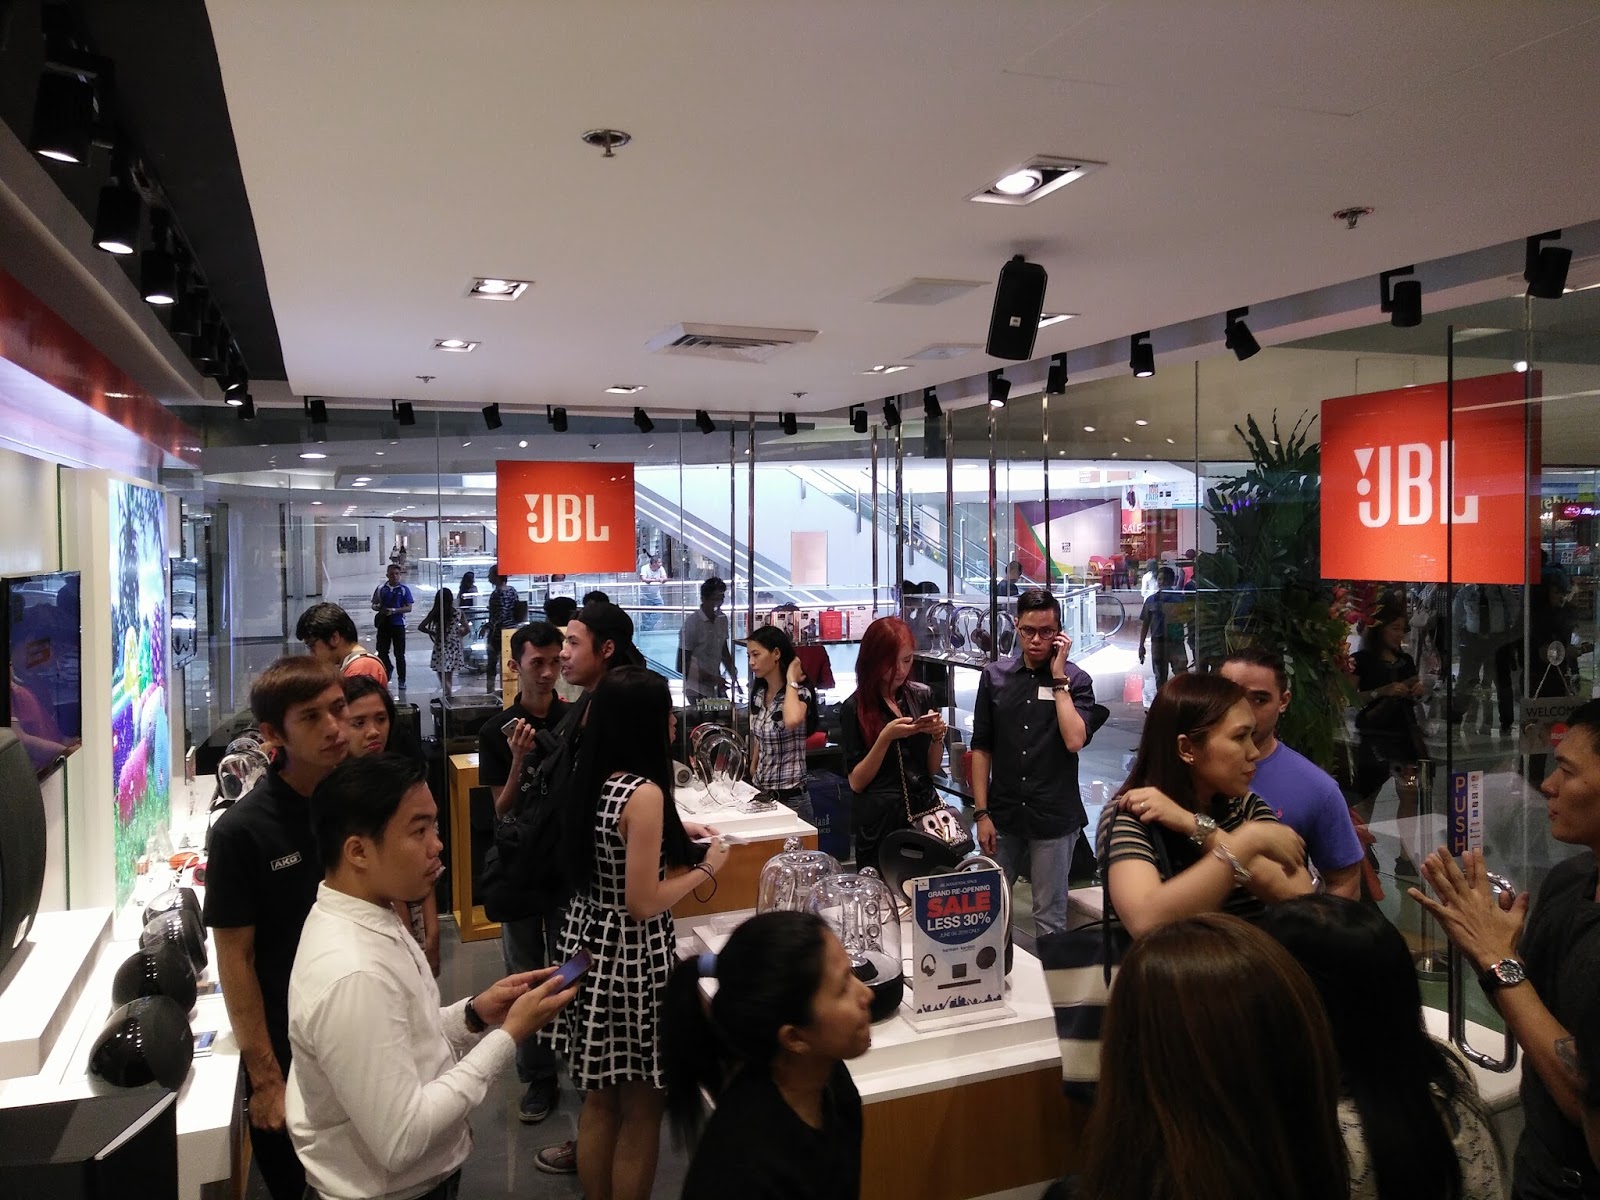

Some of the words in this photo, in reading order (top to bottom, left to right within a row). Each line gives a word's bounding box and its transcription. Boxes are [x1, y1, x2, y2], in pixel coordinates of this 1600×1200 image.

[1354, 440, 1478, 528] JBL
[524, 494, 609, 543] JBL
[1122, 525, 1141, 534] SALE
[1454, 776, 1466, 853] PUSH
[274, 855, 298, 869] AKG
[928, 889, 950, 898] GRAND
[951, 884, 991, 895] RE-OPENING
[927, 891, 991, 918] SALE
[927, 915, 961, 931] LESS
[963, 911, 991, 926] 30%
